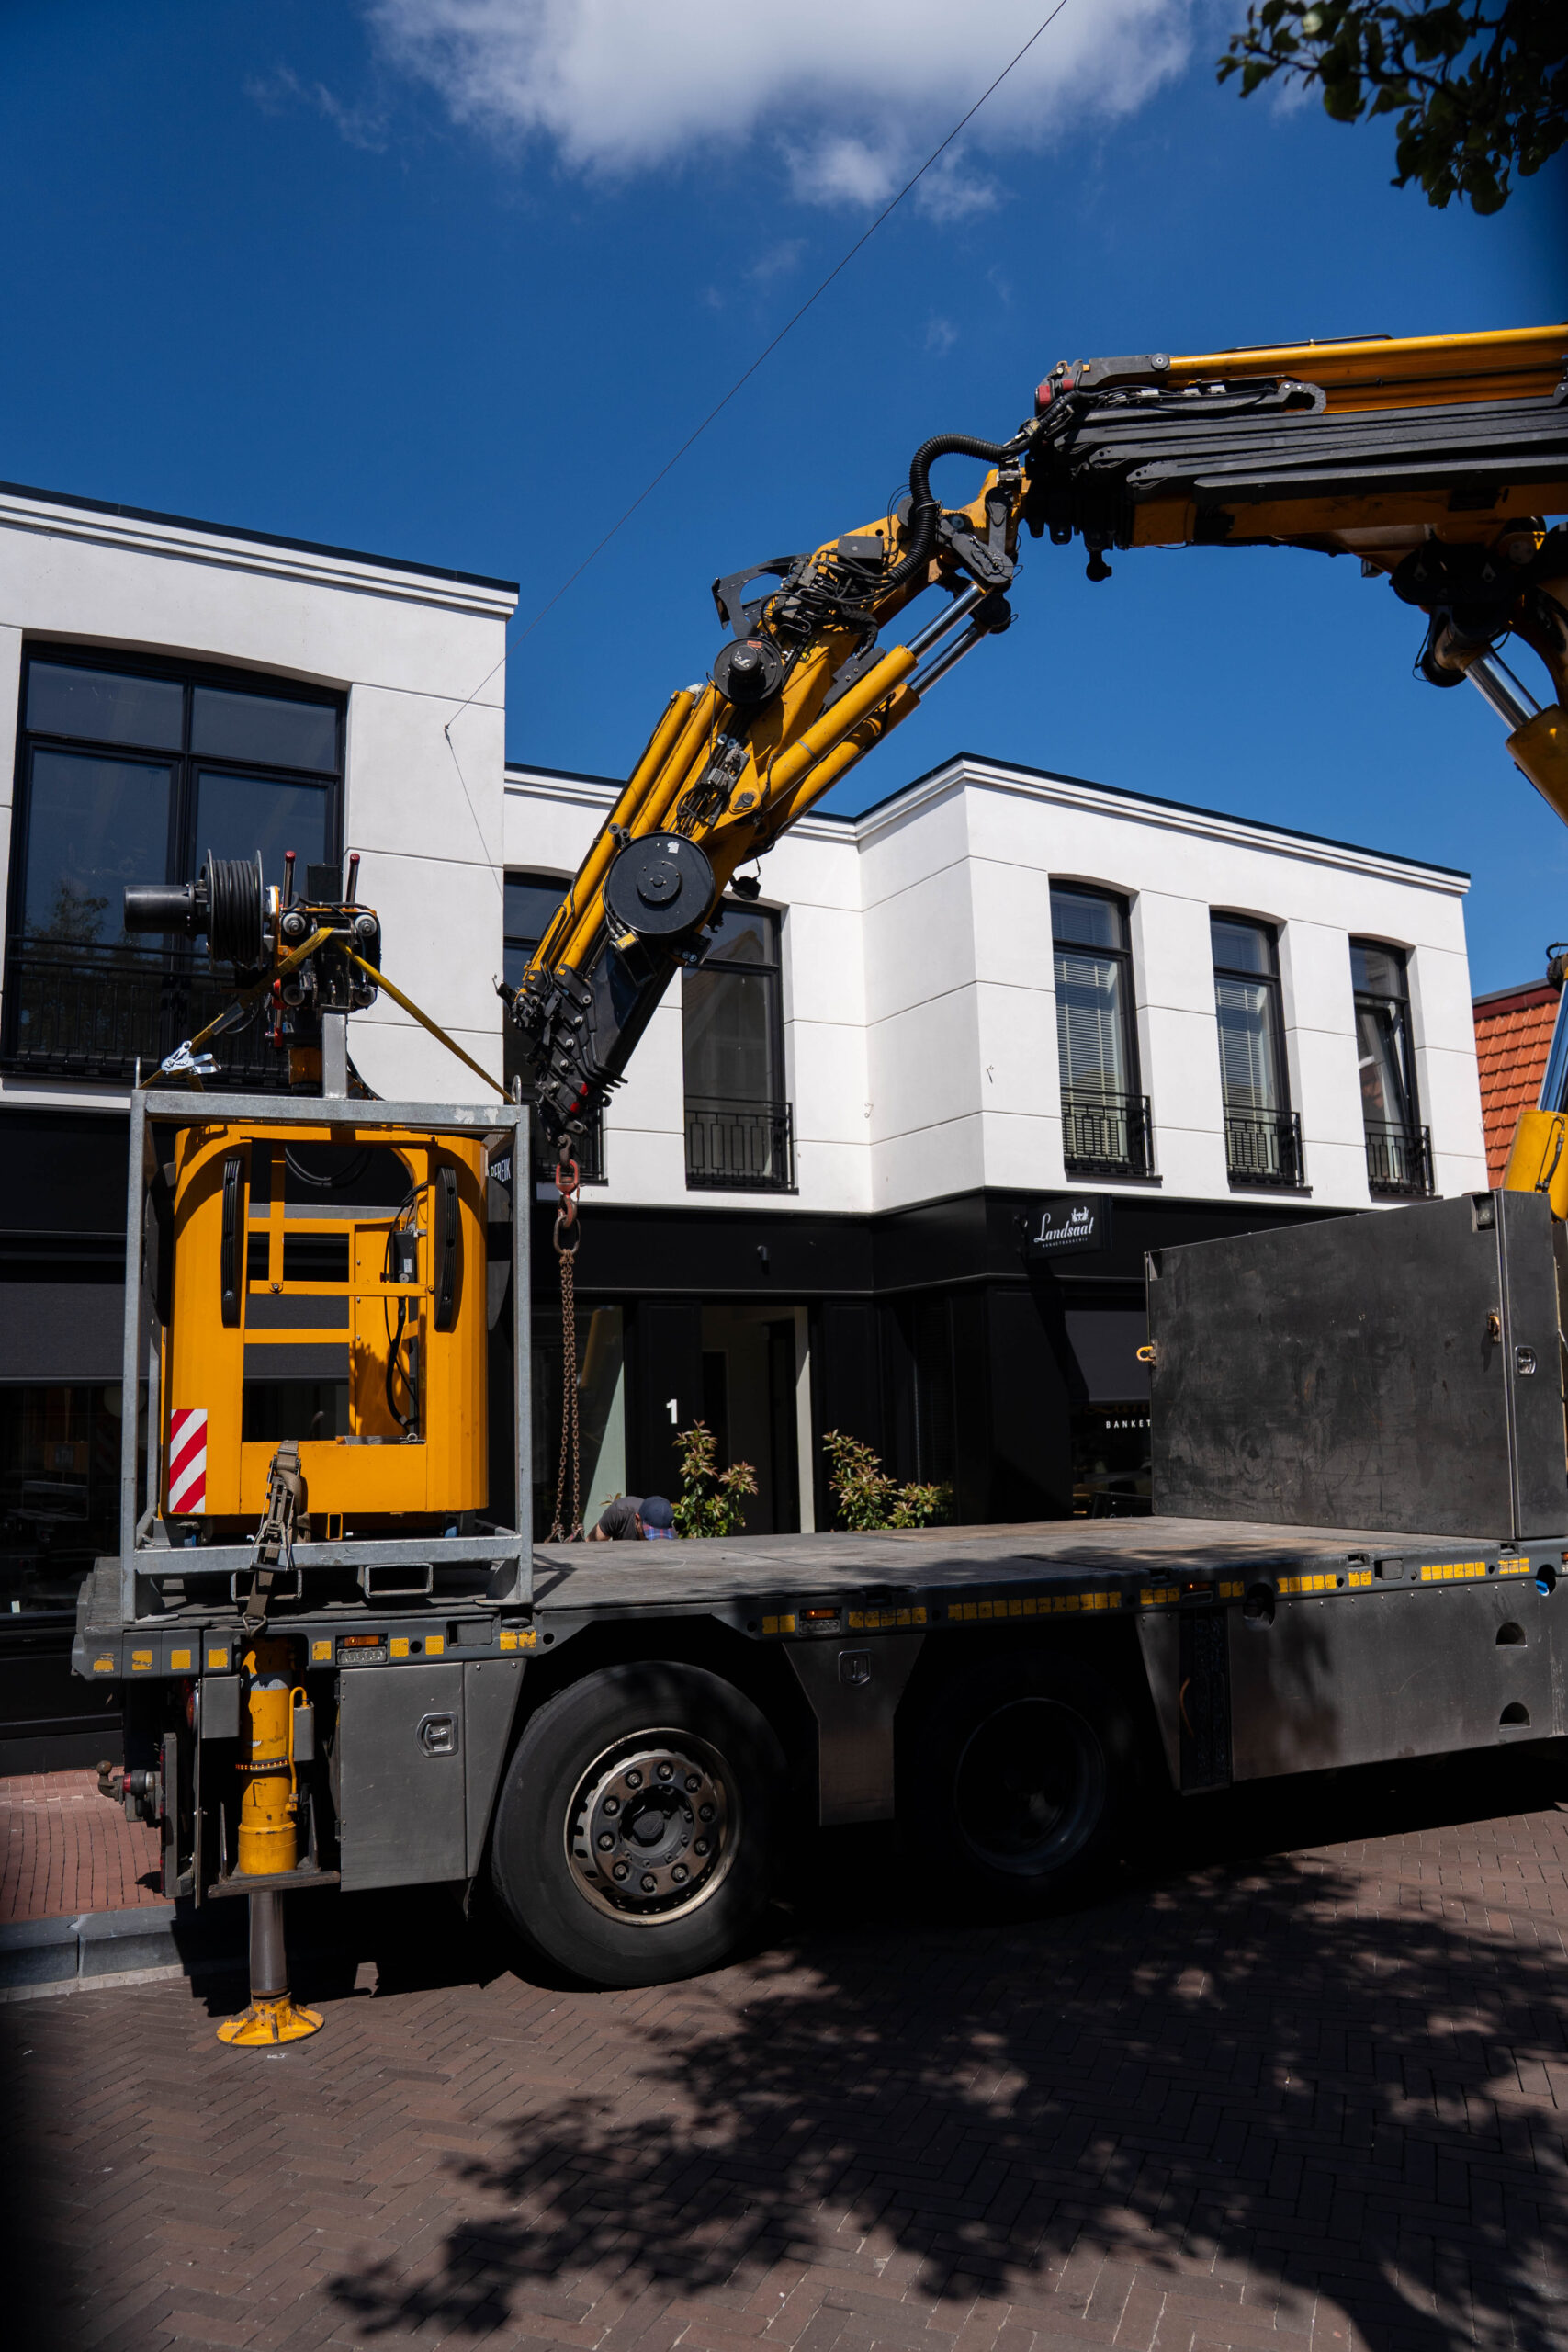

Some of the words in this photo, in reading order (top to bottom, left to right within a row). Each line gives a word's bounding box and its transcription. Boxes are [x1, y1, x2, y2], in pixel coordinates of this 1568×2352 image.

[1033, 1213, 1094, 1242] Landsaat
[666, 1398, 677, 1424] 1
[1105, 1419, 1151, 1430] BANKET
